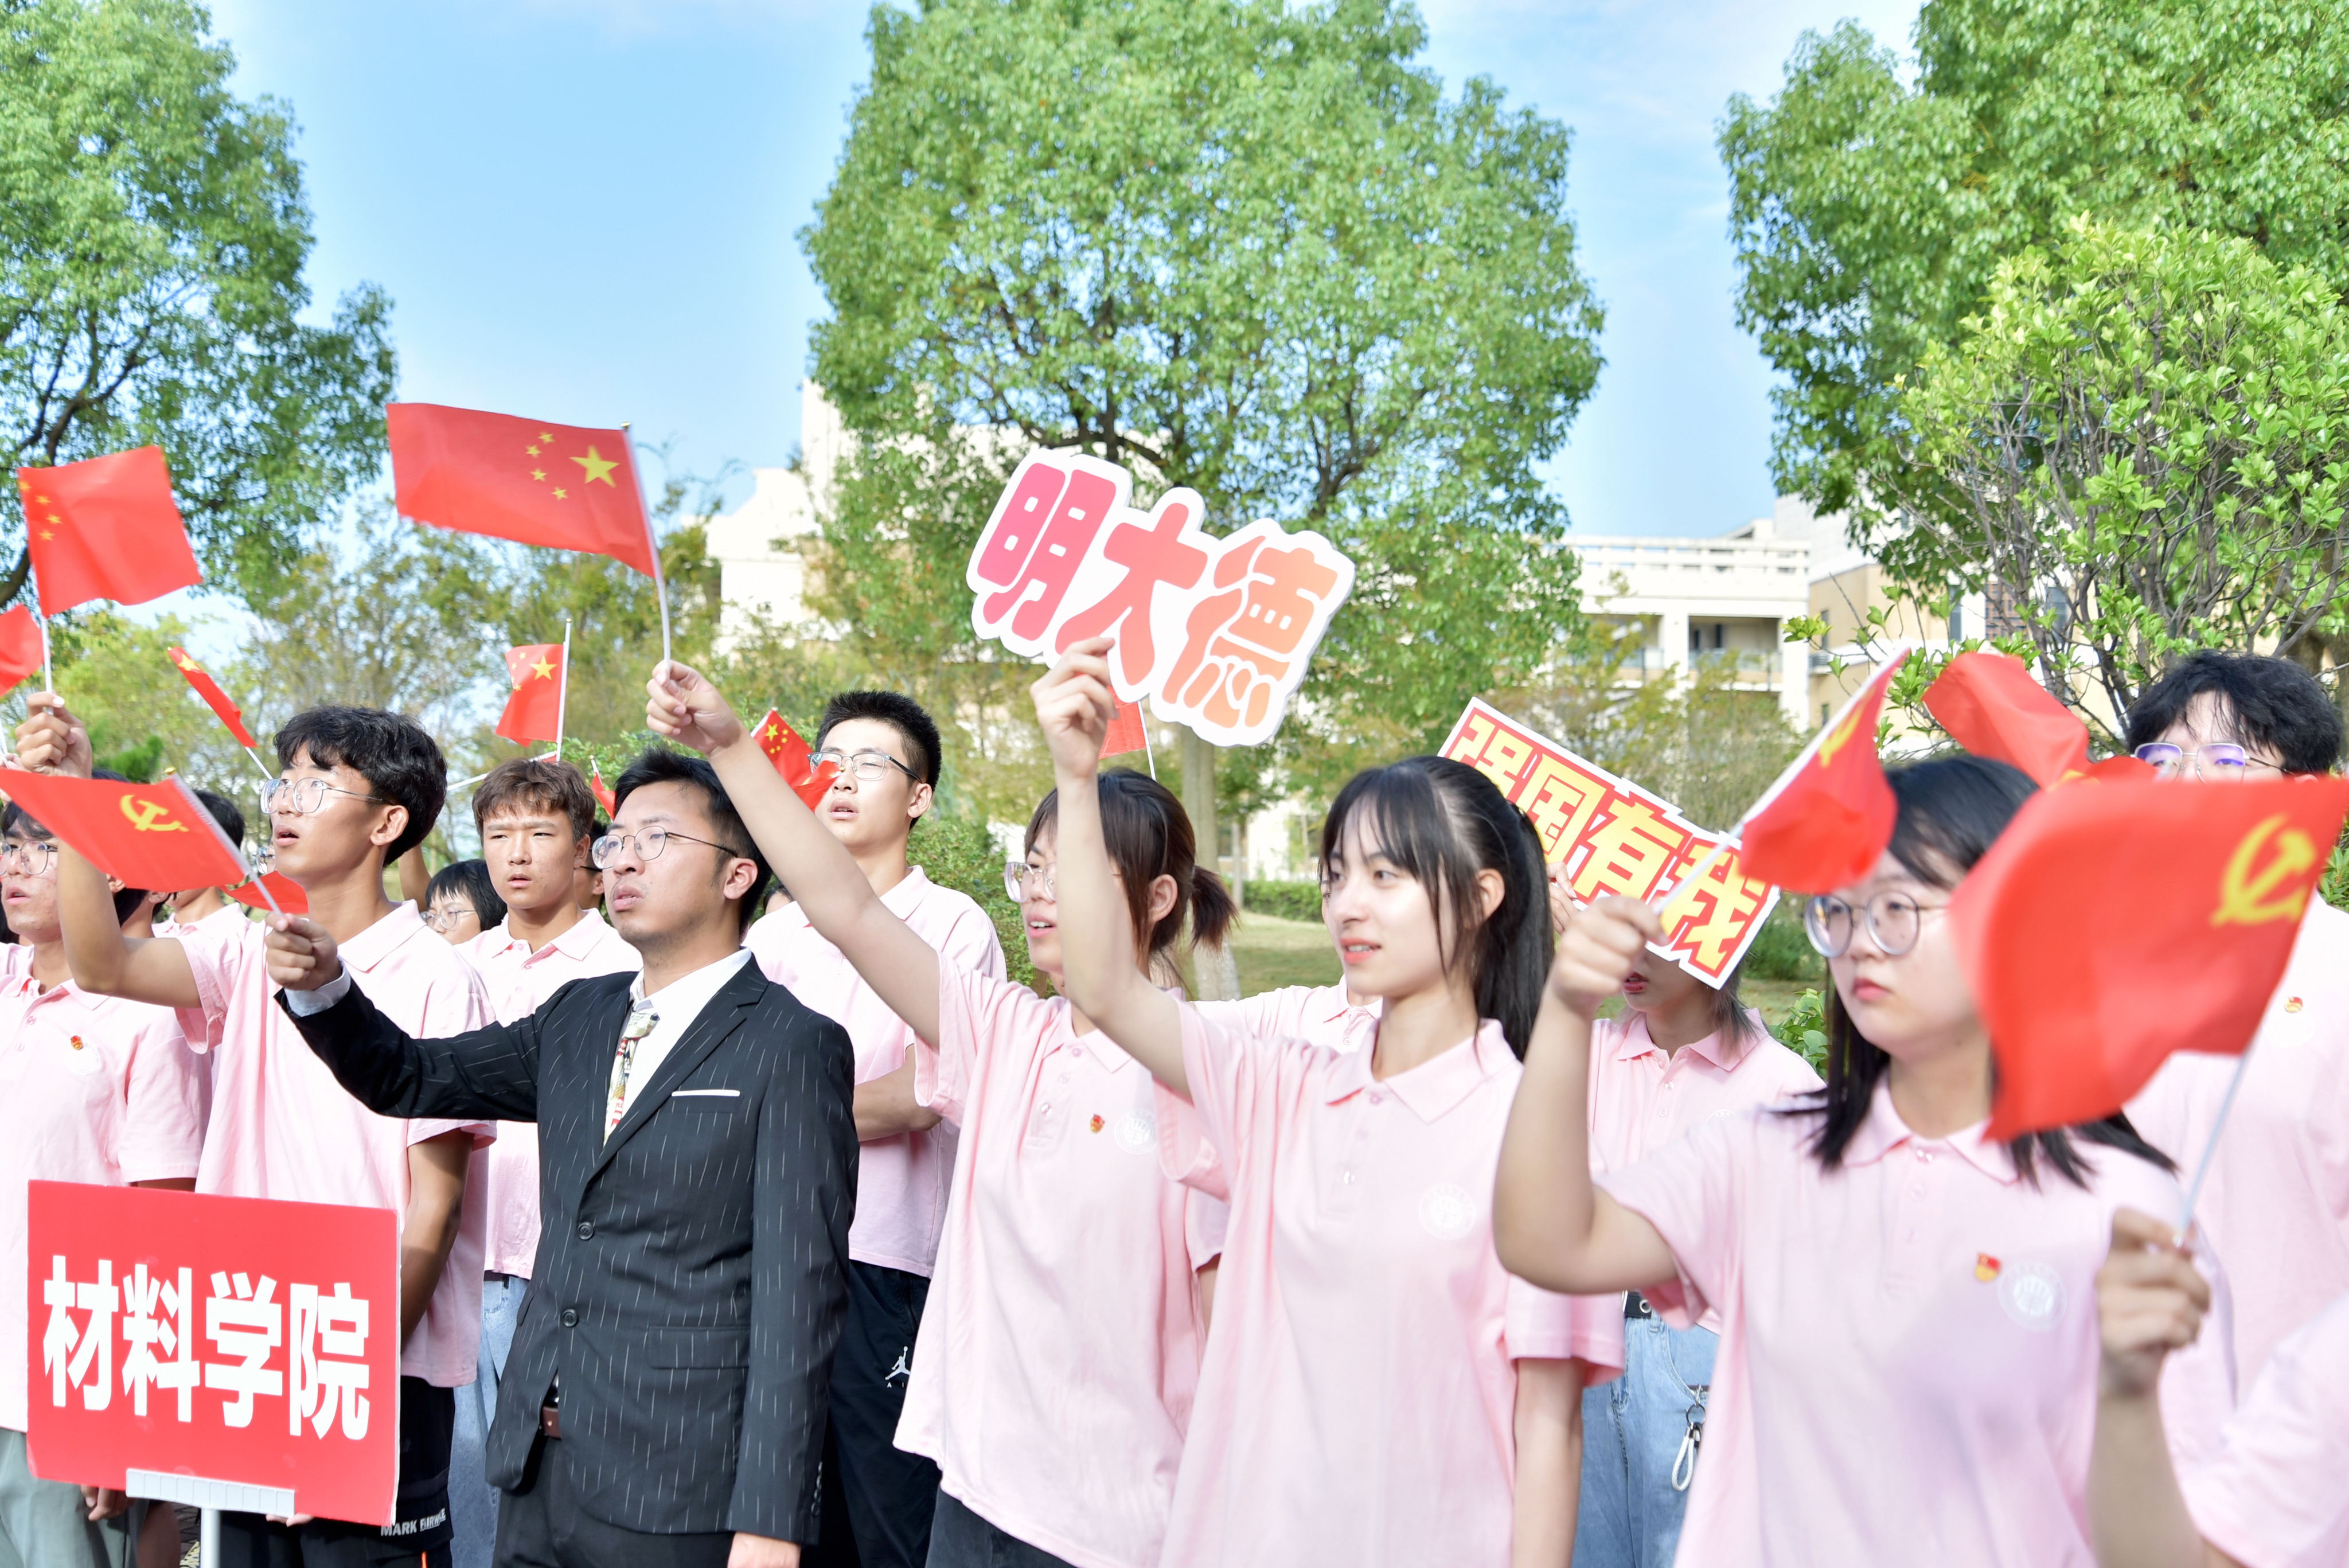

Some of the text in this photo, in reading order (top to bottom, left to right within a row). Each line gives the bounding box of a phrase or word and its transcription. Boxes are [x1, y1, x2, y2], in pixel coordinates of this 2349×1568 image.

[977, 462, 1337, 728] 明大德
[43, 1254, 370, 1440] 材料学院
[380, 1520, 417, 1536] MARK
